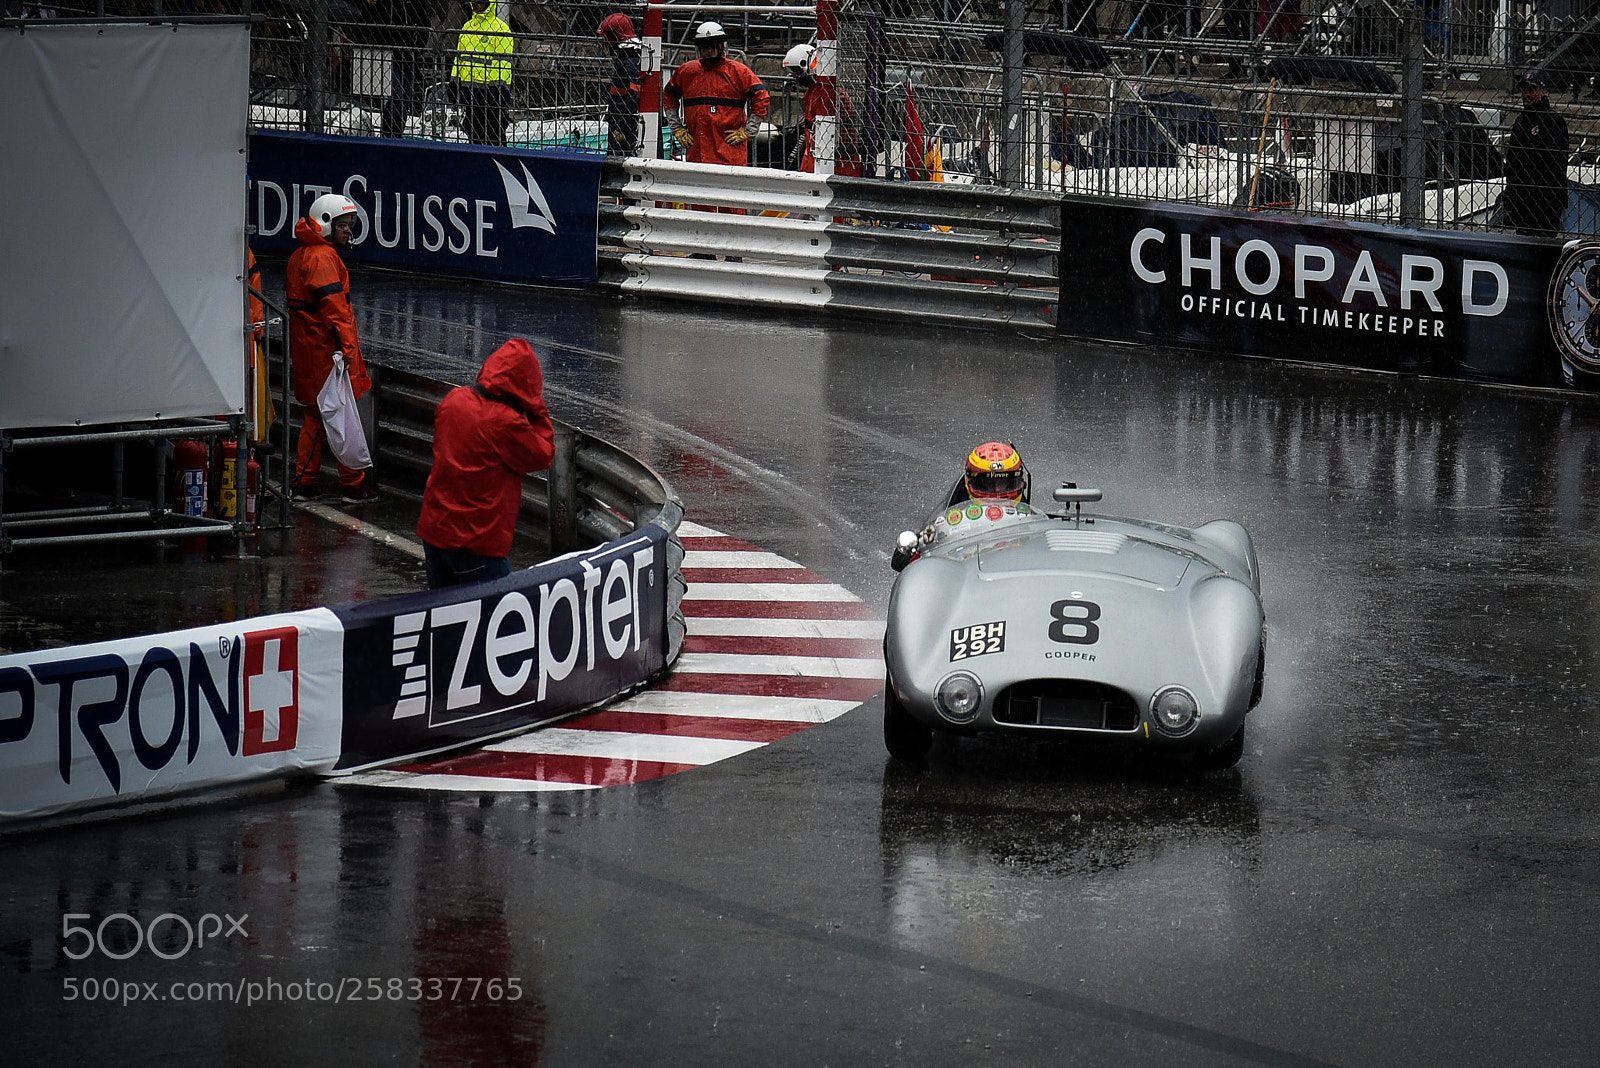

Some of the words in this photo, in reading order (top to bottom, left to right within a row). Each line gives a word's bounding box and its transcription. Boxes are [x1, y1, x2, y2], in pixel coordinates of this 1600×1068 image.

[342, 174, 498, 258] SUISSE
[1130, 227, 1510, 317] CHOPARD
[1181, 294, 1286, 322] OFFICIAL
[1298, 305, 1445, 338] TIMEKEEPER
[430, 545, 655, 711] zepter
[953, 622, 1004, 644] UBH
[1048, 599, 1101, 645] 8
[952, 637, 1001, 661] 292
[1045, 651, 1096, 662] COOPER
